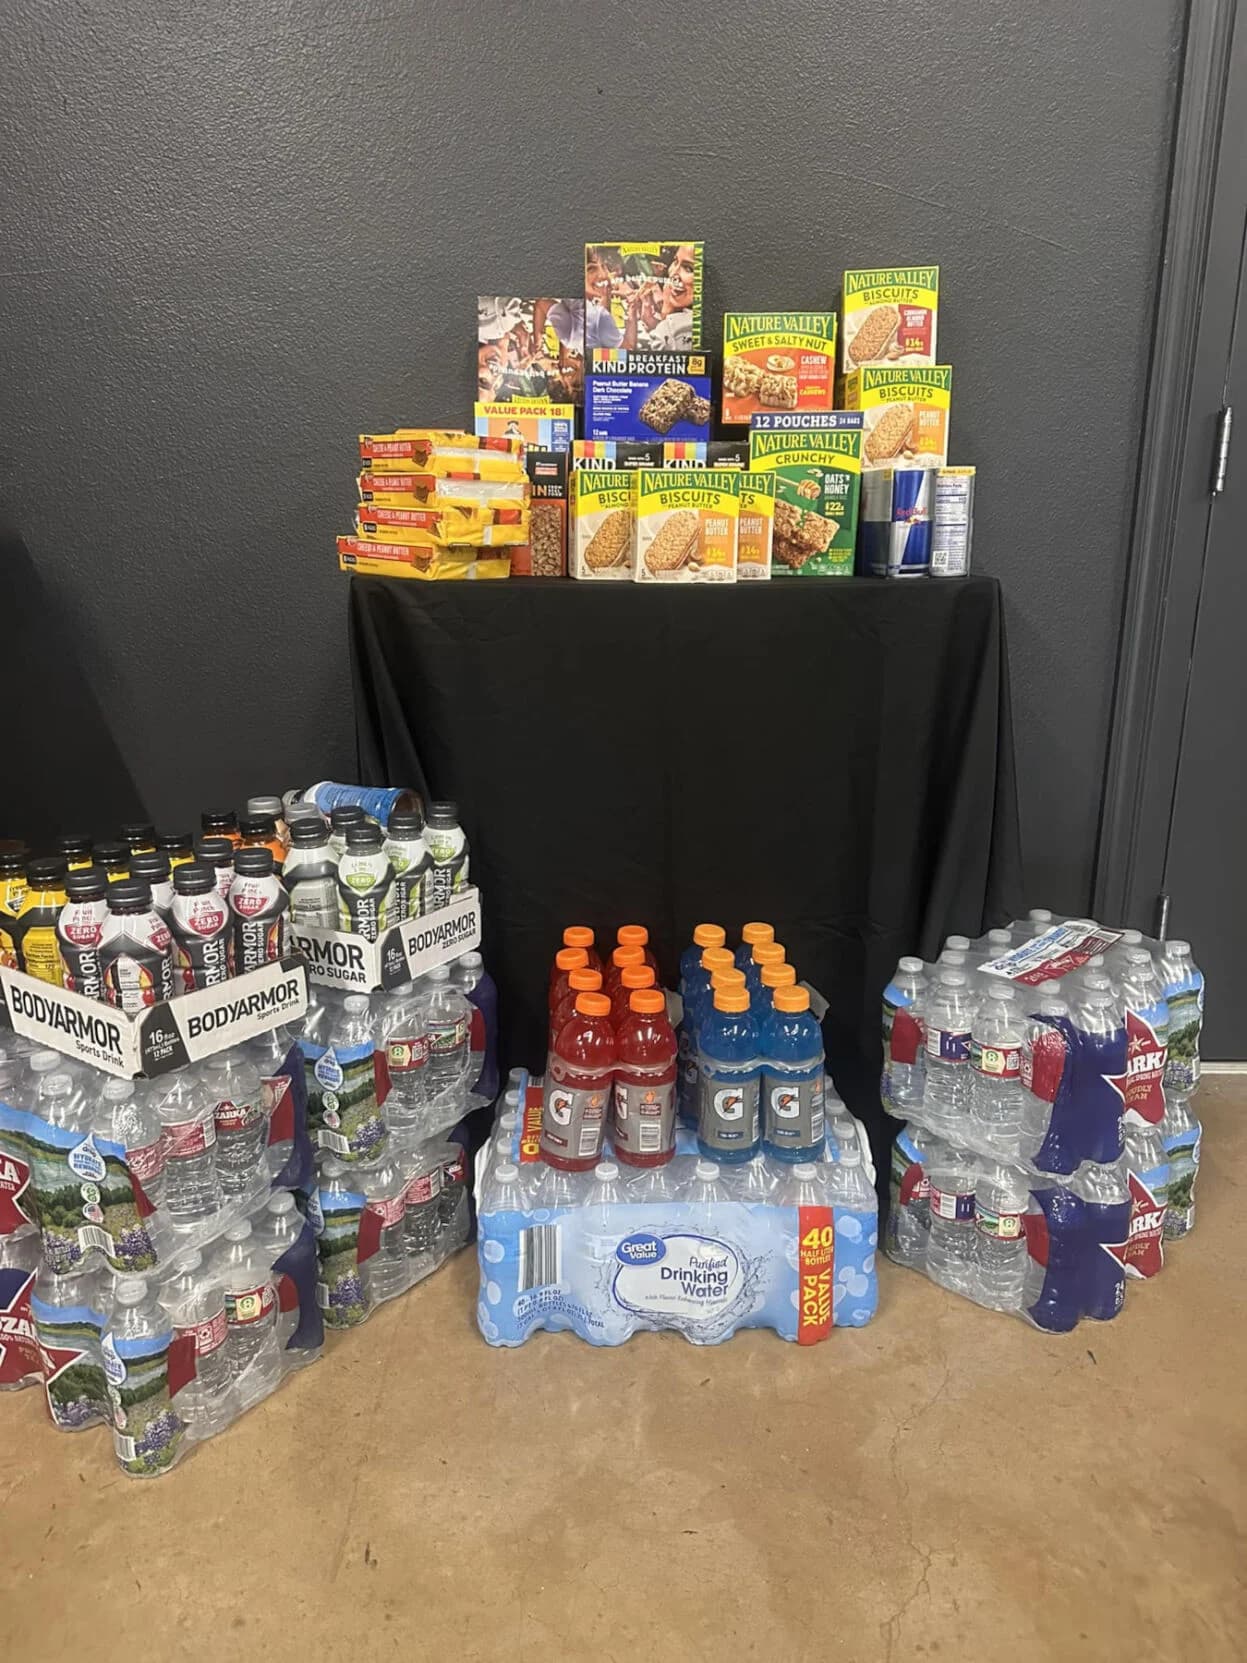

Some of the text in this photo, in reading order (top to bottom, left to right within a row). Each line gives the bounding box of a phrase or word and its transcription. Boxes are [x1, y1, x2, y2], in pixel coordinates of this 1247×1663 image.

[693, 247, 704, 301] NATURE
[849, 270, 935, 293] NATURE VALLEY
[863, 288, 920, 302] BISCUITS
[729, 314, 832, 339] NATURE VALLEY
[732, 336, 766, 352] SWEET
[774, 335, 804, 346] SALTY
[805, 337, 827, 352] NUT
[628, 354, 687, 363] BREAKFAST
[801, 355, 827, 365] CASHEW
[592, 361, 686, 375] KIND PROTEIN
[866, 368, 949, 389] NATURE VALLEY
[879, 386, 934, 398] BISCUITS
[484, 405, 562, 416] VALUE PACK 18
[755, 415, 771, 428] 12
[773, 414, 837, 428] POUCHES
[756, 432, 858, 457] NATURE VALLEY
[573, 457, 616, 470] KIND
[775, 452, 836, 465] CRUNCHY
[583, 473, 629, 493] NATURE
[643, 472, 736, 494] NATURE VALLEY
[824, 473, 844, 483] OATS
[599, 491, 631, 504] BISC
[824, 484, 850, 495] HONEY
[660, 492, 721, 505] BISCUITS
[705, 518, 729, 527] PEANUT
[705, 527, 728, 536] BUTTER
[194, 916, 219, 926] ZERO
[70, 927, 97, 935] ZERO
[408, 911, 476, 956] BODYARMOR
[442, 927, 477, 949] ZERO SUGAR
[327, 966, 367, 984] SUGAR
[187, 978, 300, 1039] BODYARMOR
[257, 999, 300, 1020] Sports Drink
[10, 985, 123, 1055] BODYARMOR
[148, 1029, 163, 1045] 16
[76, 1040, 124, 1068] Sports Drink
[549, 1090, 573, 1126] G
[714, 1087, 743, 1121] G
[771, 1086, 800, 1119] G
[527, 1107, 544, 1132] VALUE
[801, 1226, 833, 1249] 40
[621, 1241, 657, 1253] Great
[629, 1251, 657, 1260] Value
[800, 1249, 820, 1258] HALF
[689, 1255, 729, 1272] Purified
[661, 1266, 728, 1285] Drinking
[681, 1281, 729, 1298] Water
[818, 1268, 831, 1325] VALUE
[803, 1275, 818, 1327] PACK
